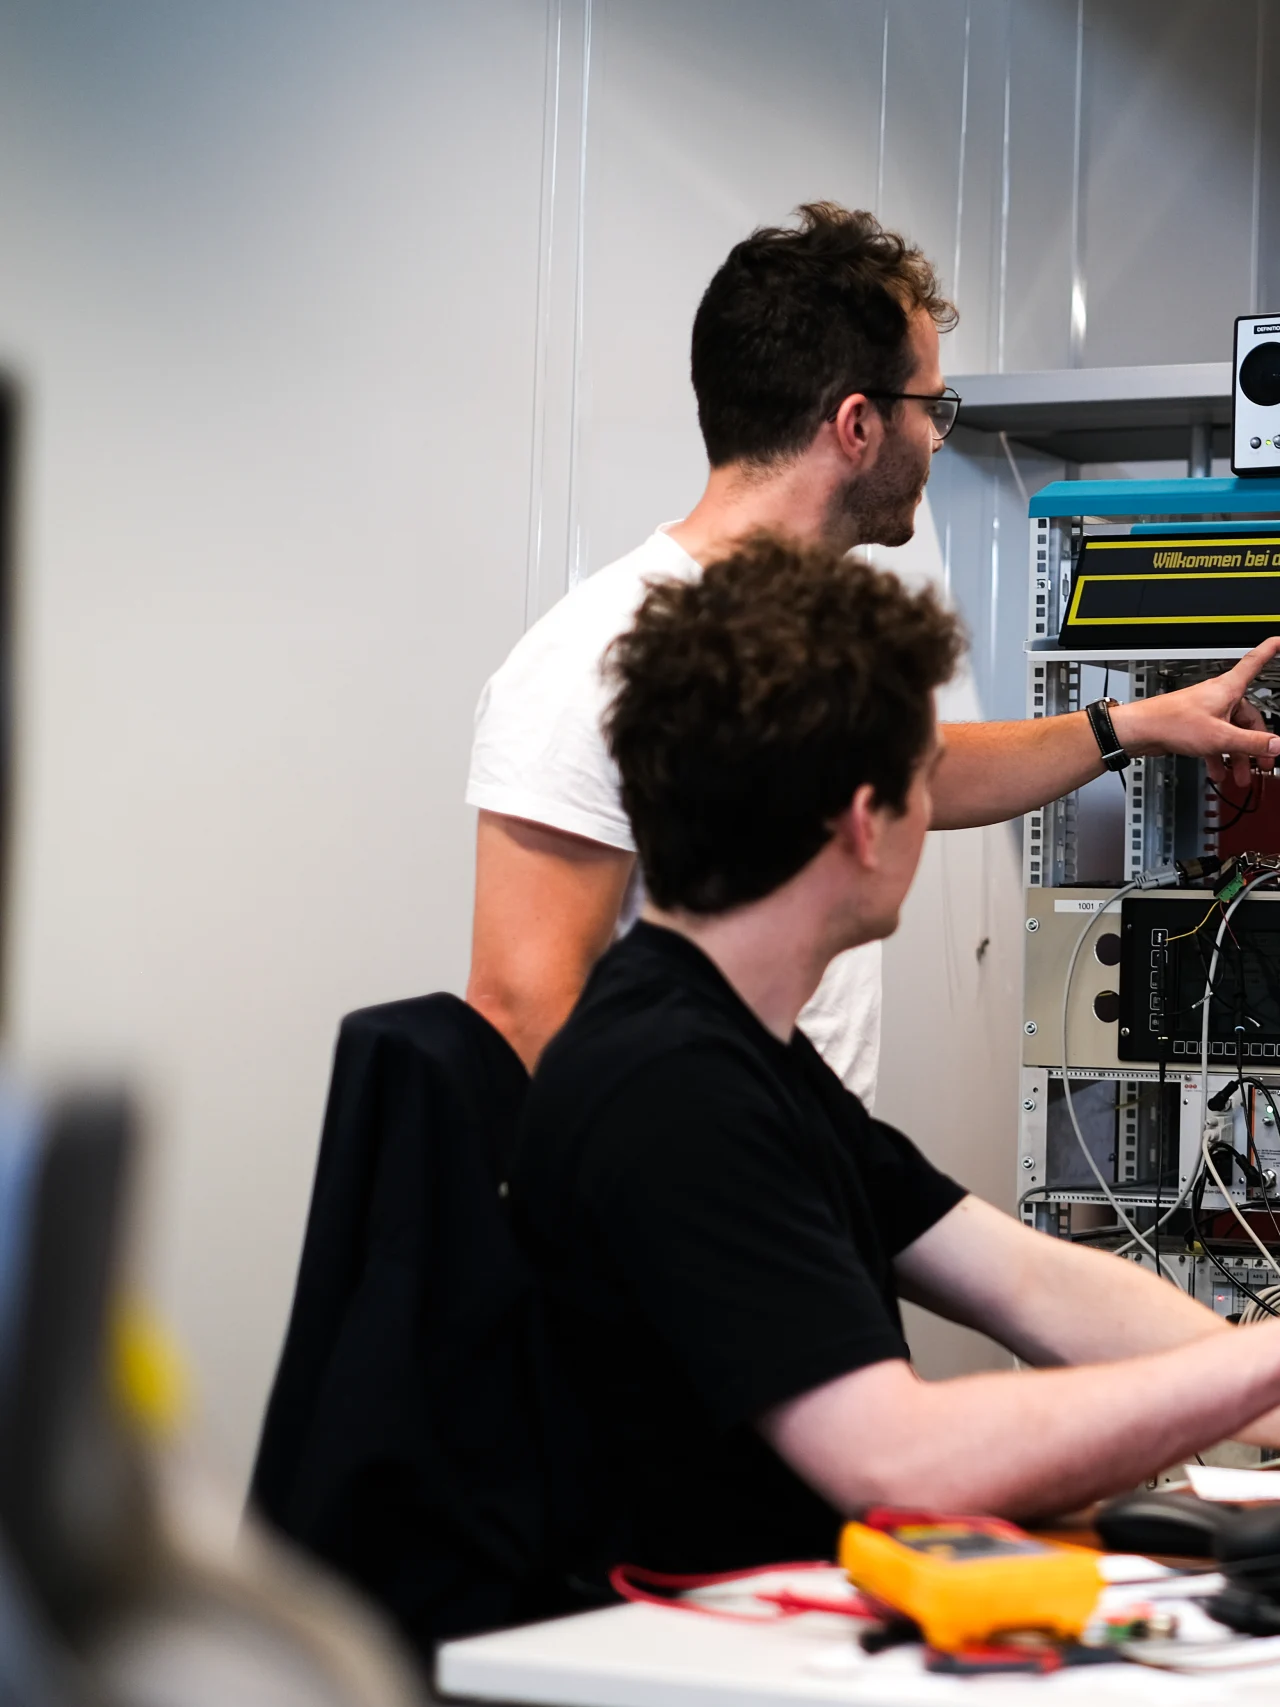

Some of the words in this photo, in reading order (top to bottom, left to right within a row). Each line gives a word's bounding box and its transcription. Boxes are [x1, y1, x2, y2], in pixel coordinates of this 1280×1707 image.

[1153, 551, 1241, 568] Willkommen
[1244, 550, 1270, 567] bei
[1078, 902, 1094, 910] 1001
